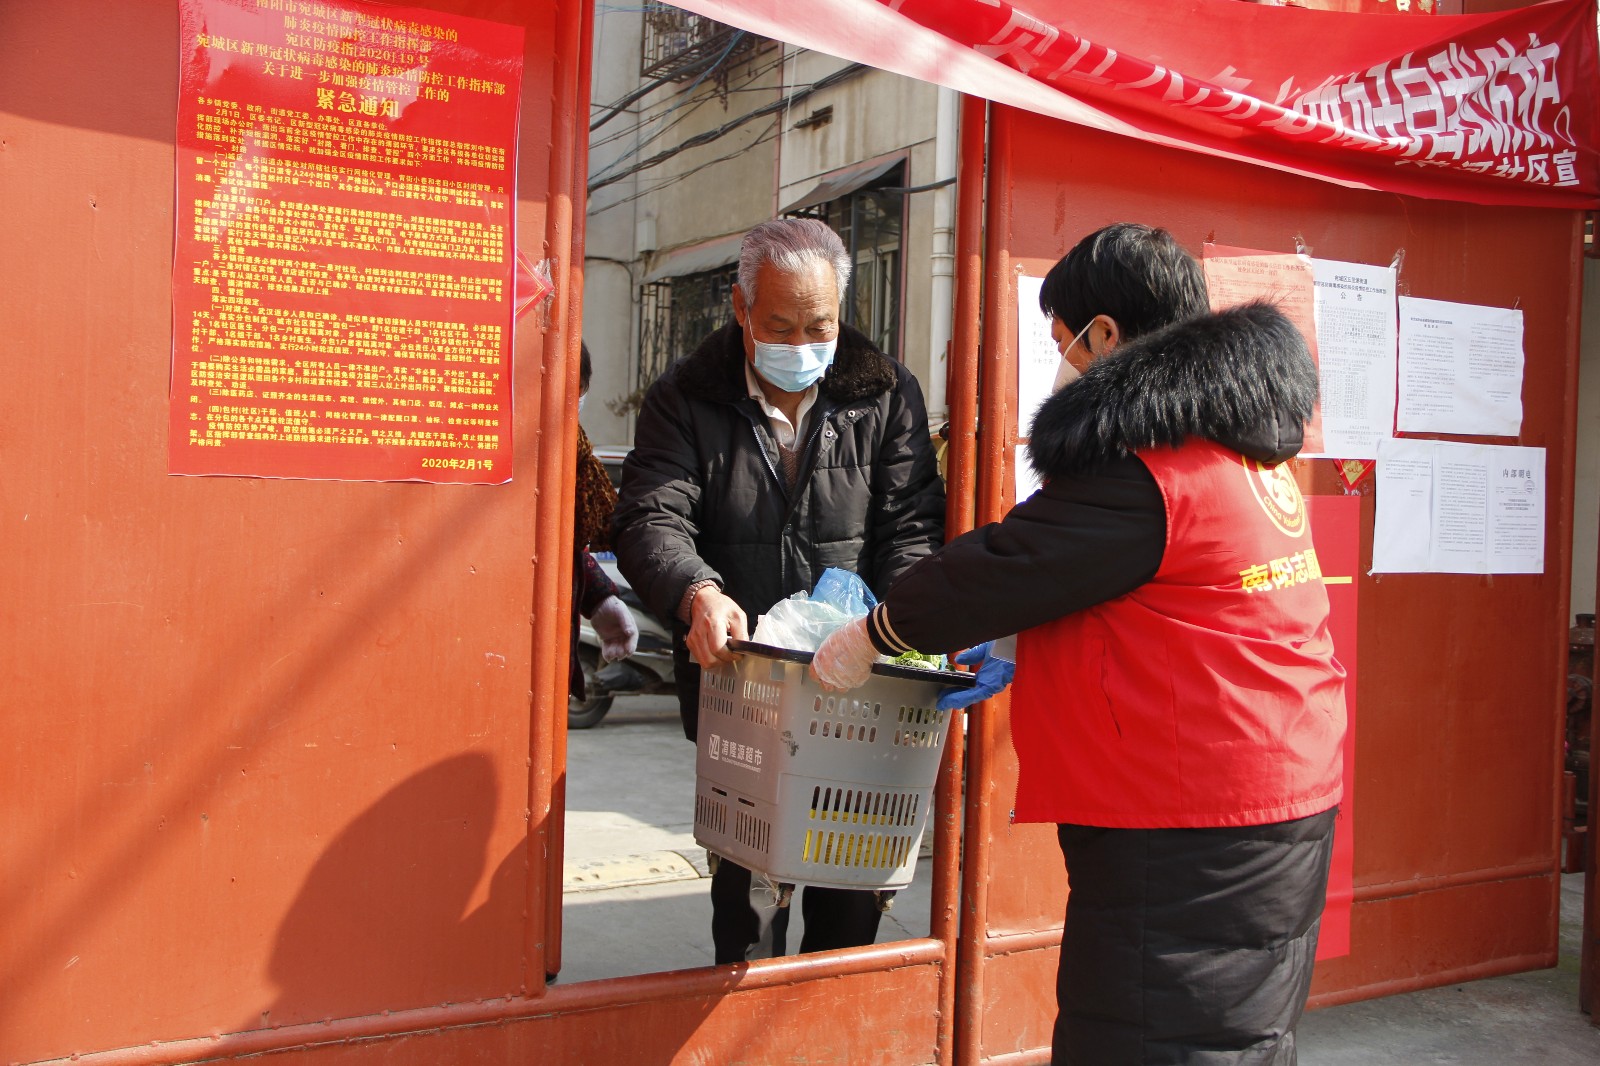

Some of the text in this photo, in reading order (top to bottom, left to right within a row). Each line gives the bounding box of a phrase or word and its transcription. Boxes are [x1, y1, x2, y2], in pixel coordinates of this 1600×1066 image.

[282, 15, 433, 53] 肺炎疫情防控工作指挥部
[261, 60, 449, 103] 关于进一步加强疫情管控工作的
[314, 86, 400, 120] 紧急通知
[421, 456, 493, 471] 2020年2月1号
